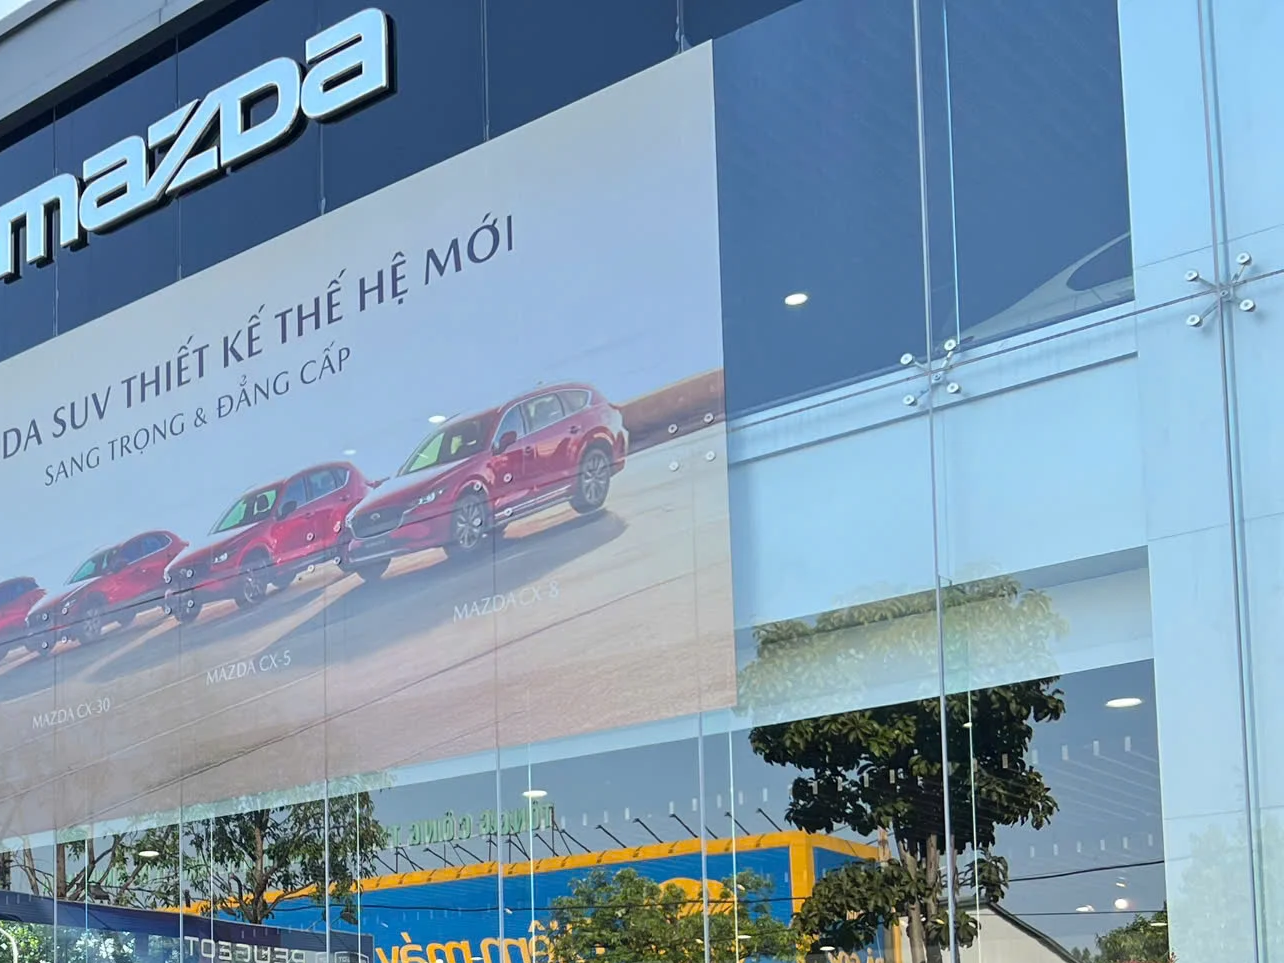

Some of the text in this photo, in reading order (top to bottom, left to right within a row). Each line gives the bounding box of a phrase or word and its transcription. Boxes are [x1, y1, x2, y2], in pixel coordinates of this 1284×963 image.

[51, 385, 112, 439] SUV
[120, 334, 210, 409] THIẾT
[222, 303, 266, 369] KẾ
[274, 267, 348, 345] THẾ
[358, 250, 409, 313] HỆ
[423, 211, 514, 286] MỚI
[44, 446, 101, 487] SANG
[107, 412, 185, 462] TRỌNG
[193, 406, 208, 428] &
[299, 340, 352, 385] CẤP
[453, 591, 517, 625] MAZDA
[205, 649, 292, 687] MAZDA CX-5
[32, 697, 111, 729] MAZDA CX-30
